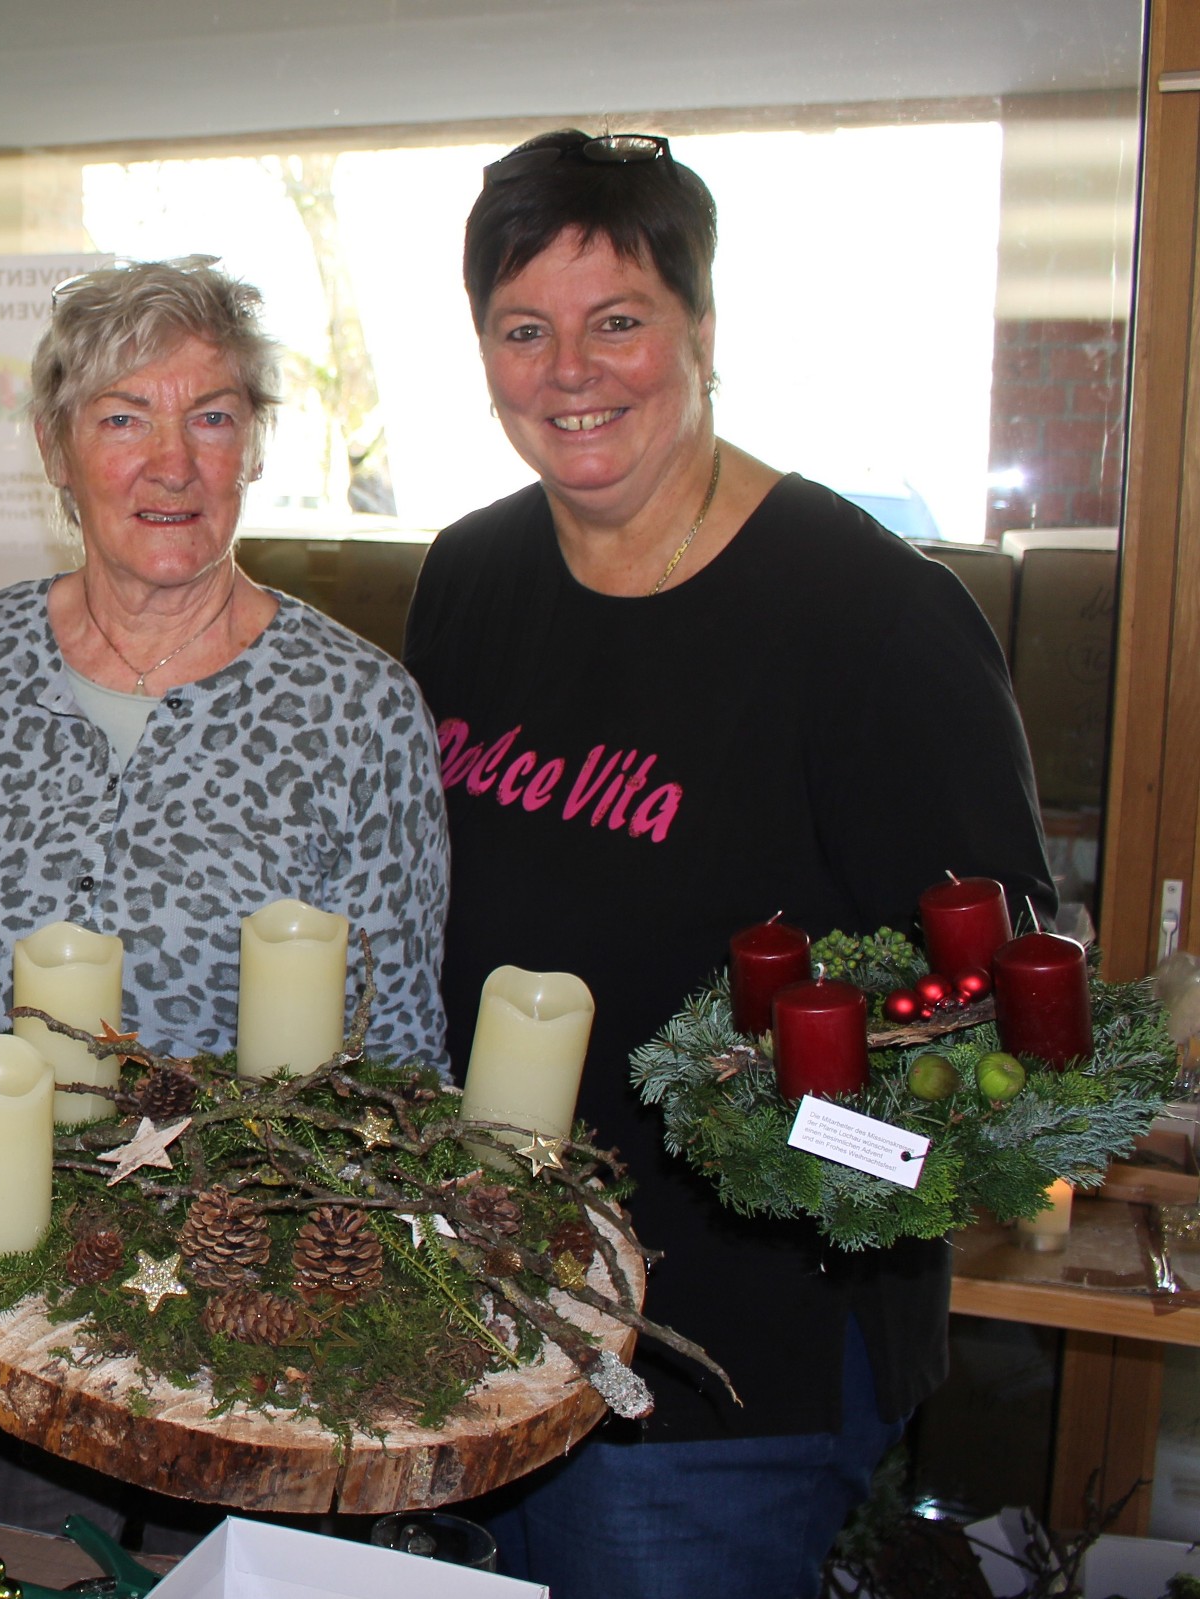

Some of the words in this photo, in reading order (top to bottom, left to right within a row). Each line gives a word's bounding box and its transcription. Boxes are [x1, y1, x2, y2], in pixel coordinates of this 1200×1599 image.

[436, 717, 566, 812] Dolce
[562, 743, 684, 843] Vita
[802, 1134, 814, 1143] und
[814, 1138, 825, 1147] ein
[825, 1141, 847, 1155] Frohes
[804, 1127, 822, 1137] einen
[822, 1133, 861, 1151] besinnlichen
[861, 1146, 884, 1160] Advent
[807, 1119, 818, 1127] der
[819, 1122, 838, 1134] Pfarre
[838, 1128, 862, 1143] Lochau
[862, 1138, 893, 1154] wünschen
[809, 1111, 821, 1120] Die
[821, 1115, 855, 1132] Mitarbeiter
[854, 1127, 866, 1137] des
[867, 1131, 915, 1153] Missionskreises
